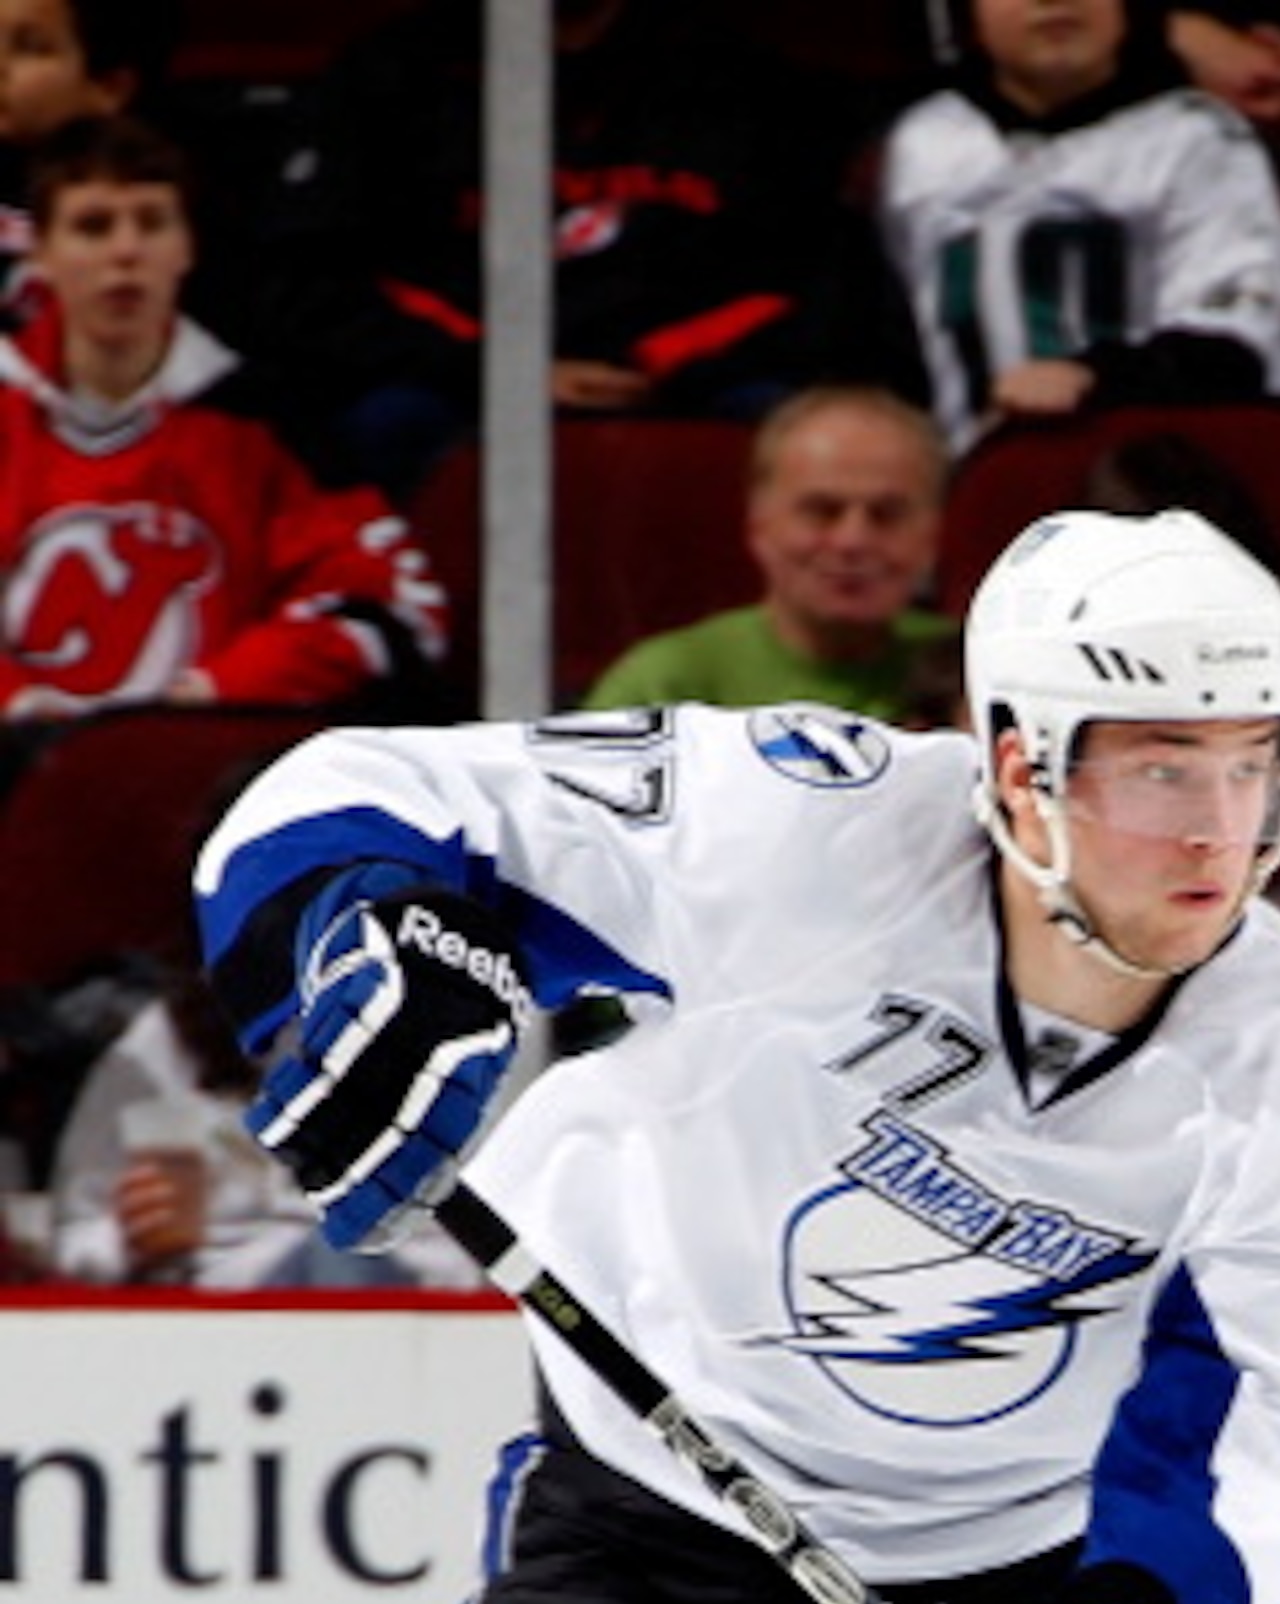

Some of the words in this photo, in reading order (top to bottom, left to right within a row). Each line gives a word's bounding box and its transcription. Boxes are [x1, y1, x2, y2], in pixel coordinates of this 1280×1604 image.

[821, 993, 994, 1112] 77
[847, 1112, 1008, 1245] TAMPA
[996, 1204, 1120, 1282] BAY
